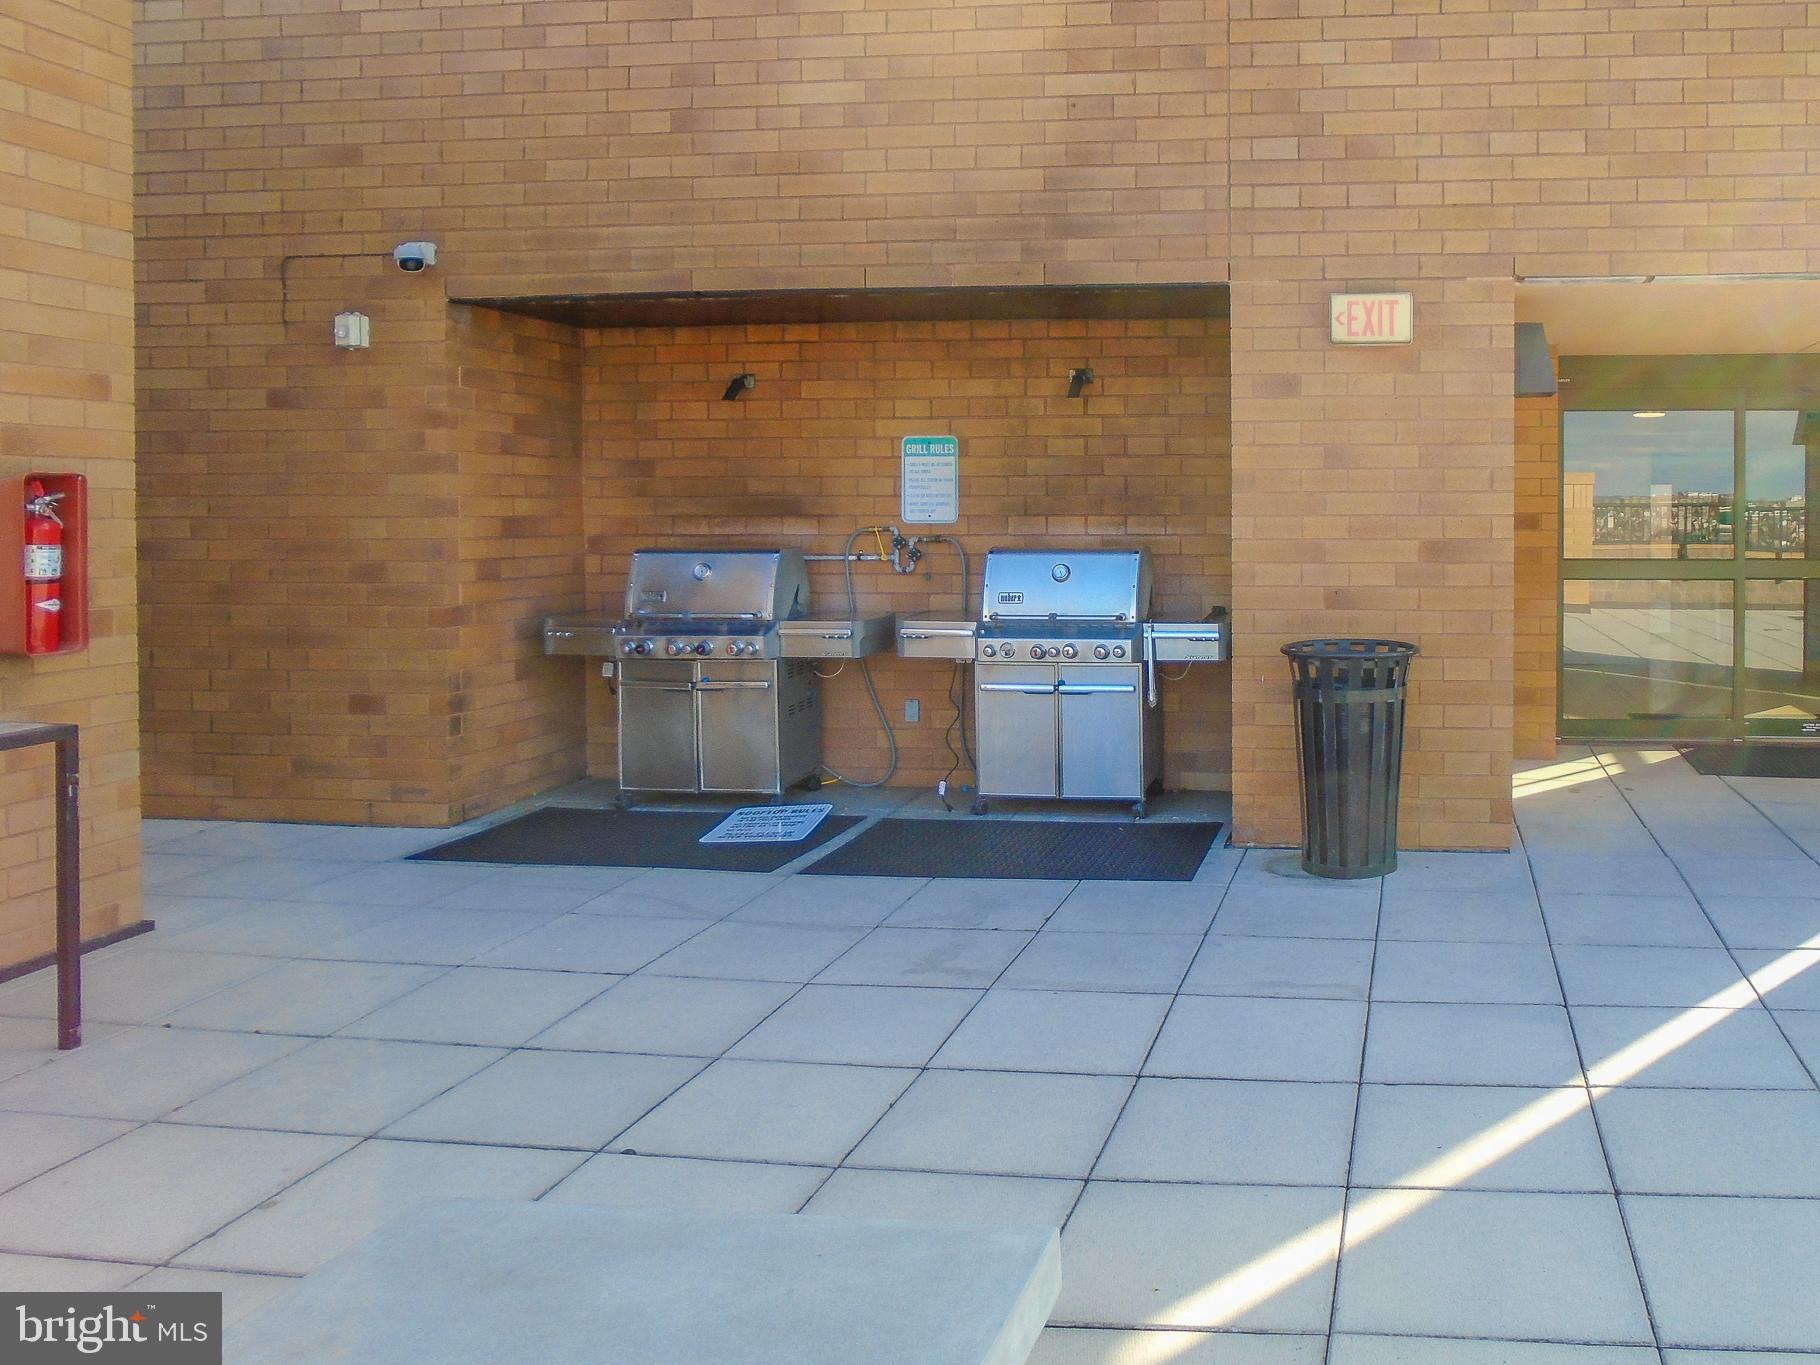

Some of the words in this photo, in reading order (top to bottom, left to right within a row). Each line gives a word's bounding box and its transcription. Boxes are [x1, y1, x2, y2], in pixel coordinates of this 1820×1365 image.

[1347, 300, 1399, 336] EXIT
[906, 444, 928, 454] GRILL
[930, 444, 954, 454] RULES
[791, 806, 825, 814] RULES
